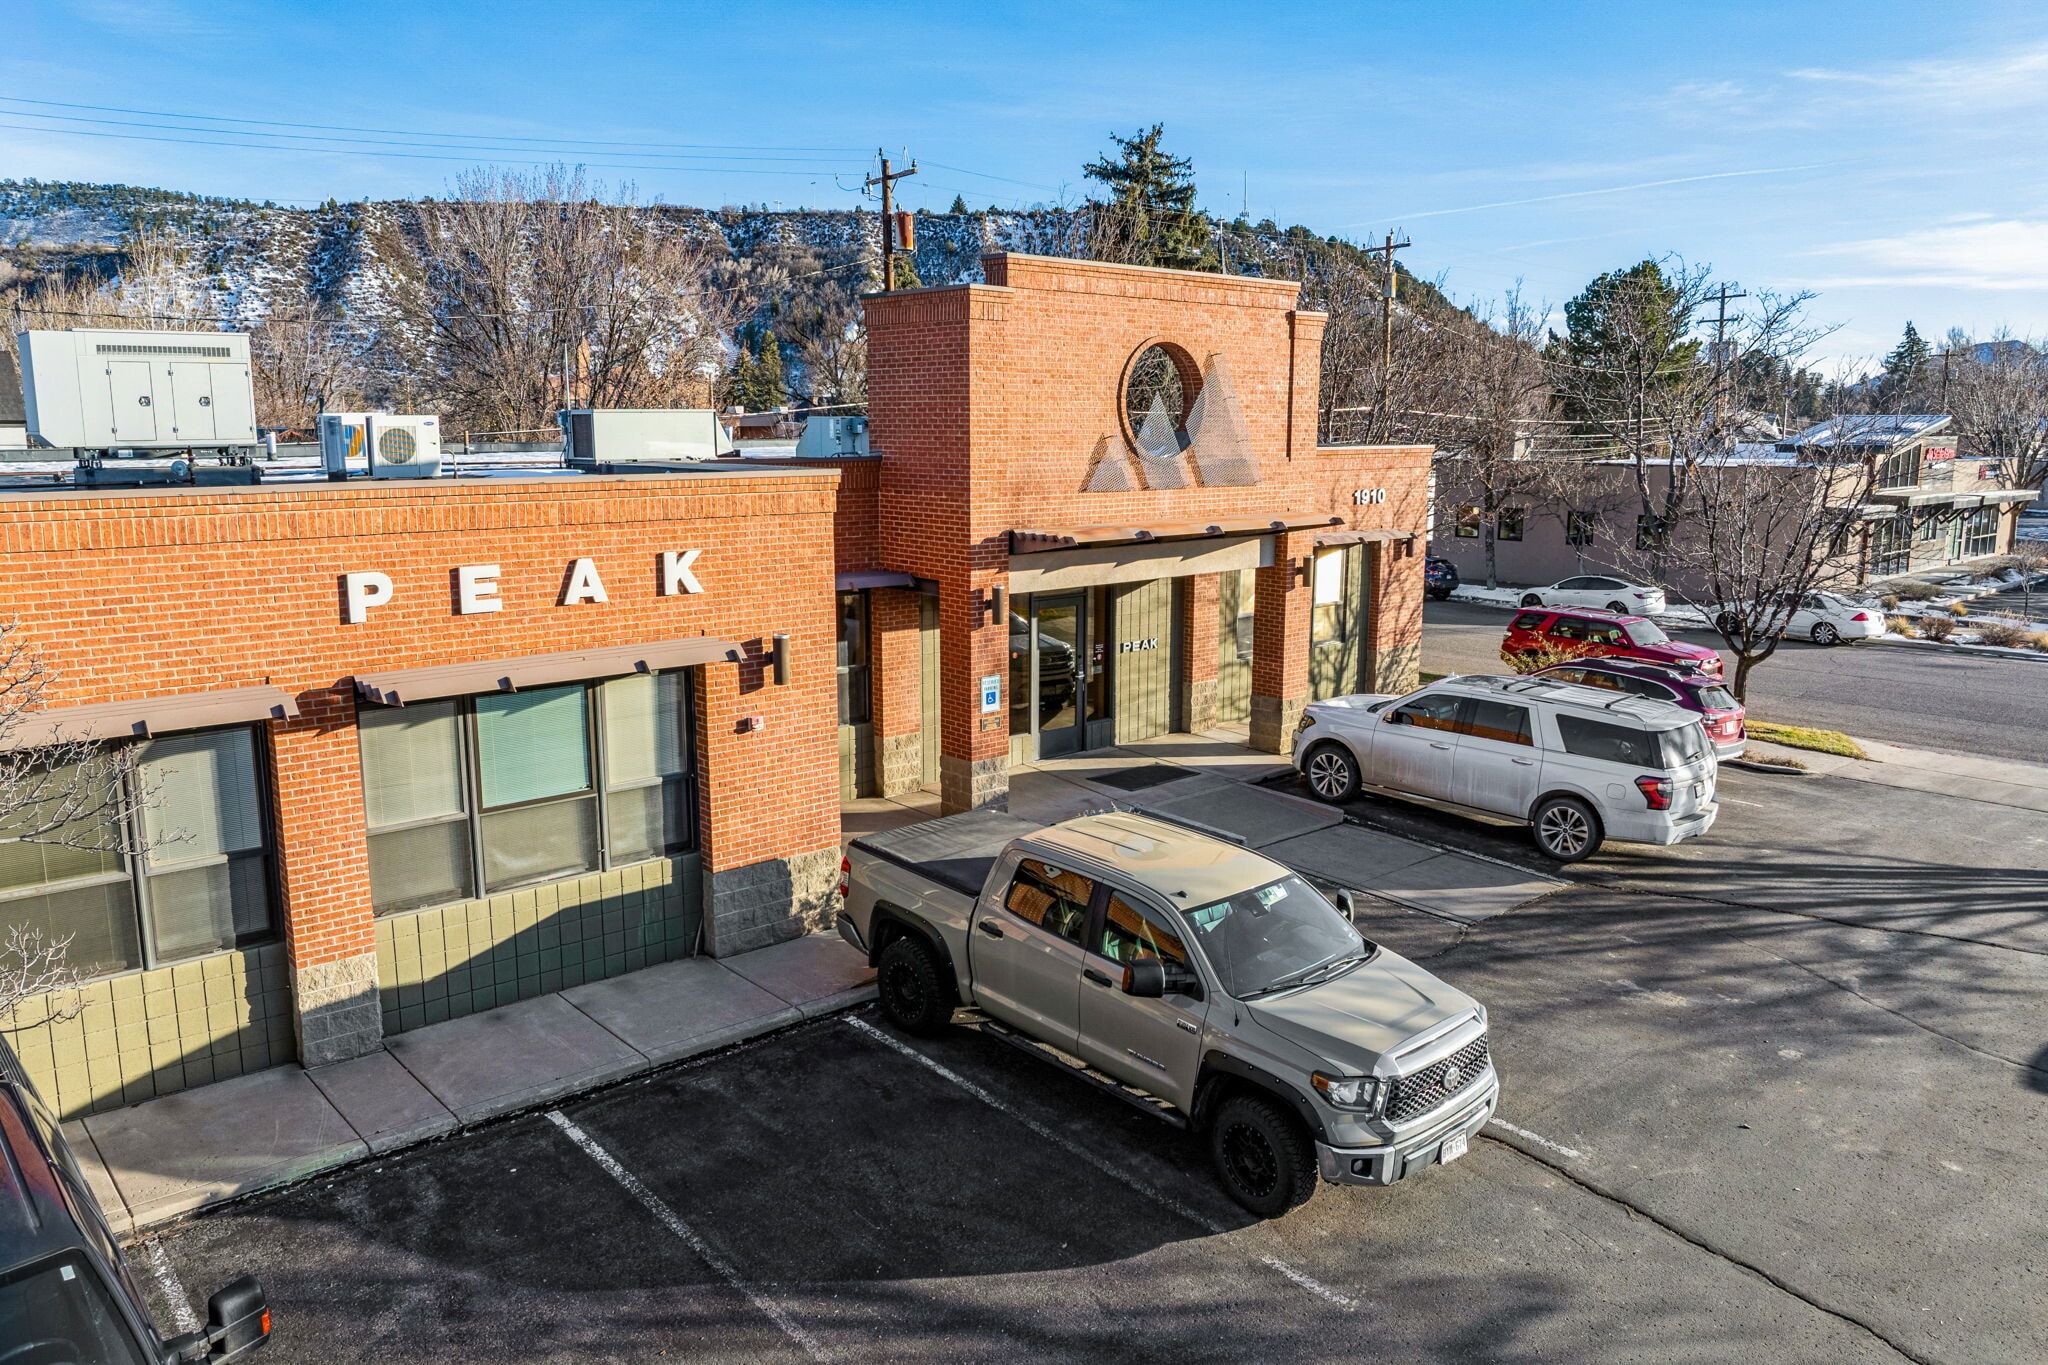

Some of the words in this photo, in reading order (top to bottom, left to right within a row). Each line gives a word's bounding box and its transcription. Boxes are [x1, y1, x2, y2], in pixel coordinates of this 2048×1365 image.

[1354, 488, 1387, 505] 1910
[346, 549, 705, 624] PEAK
[1122, 637, 1159, 654] PEAK
